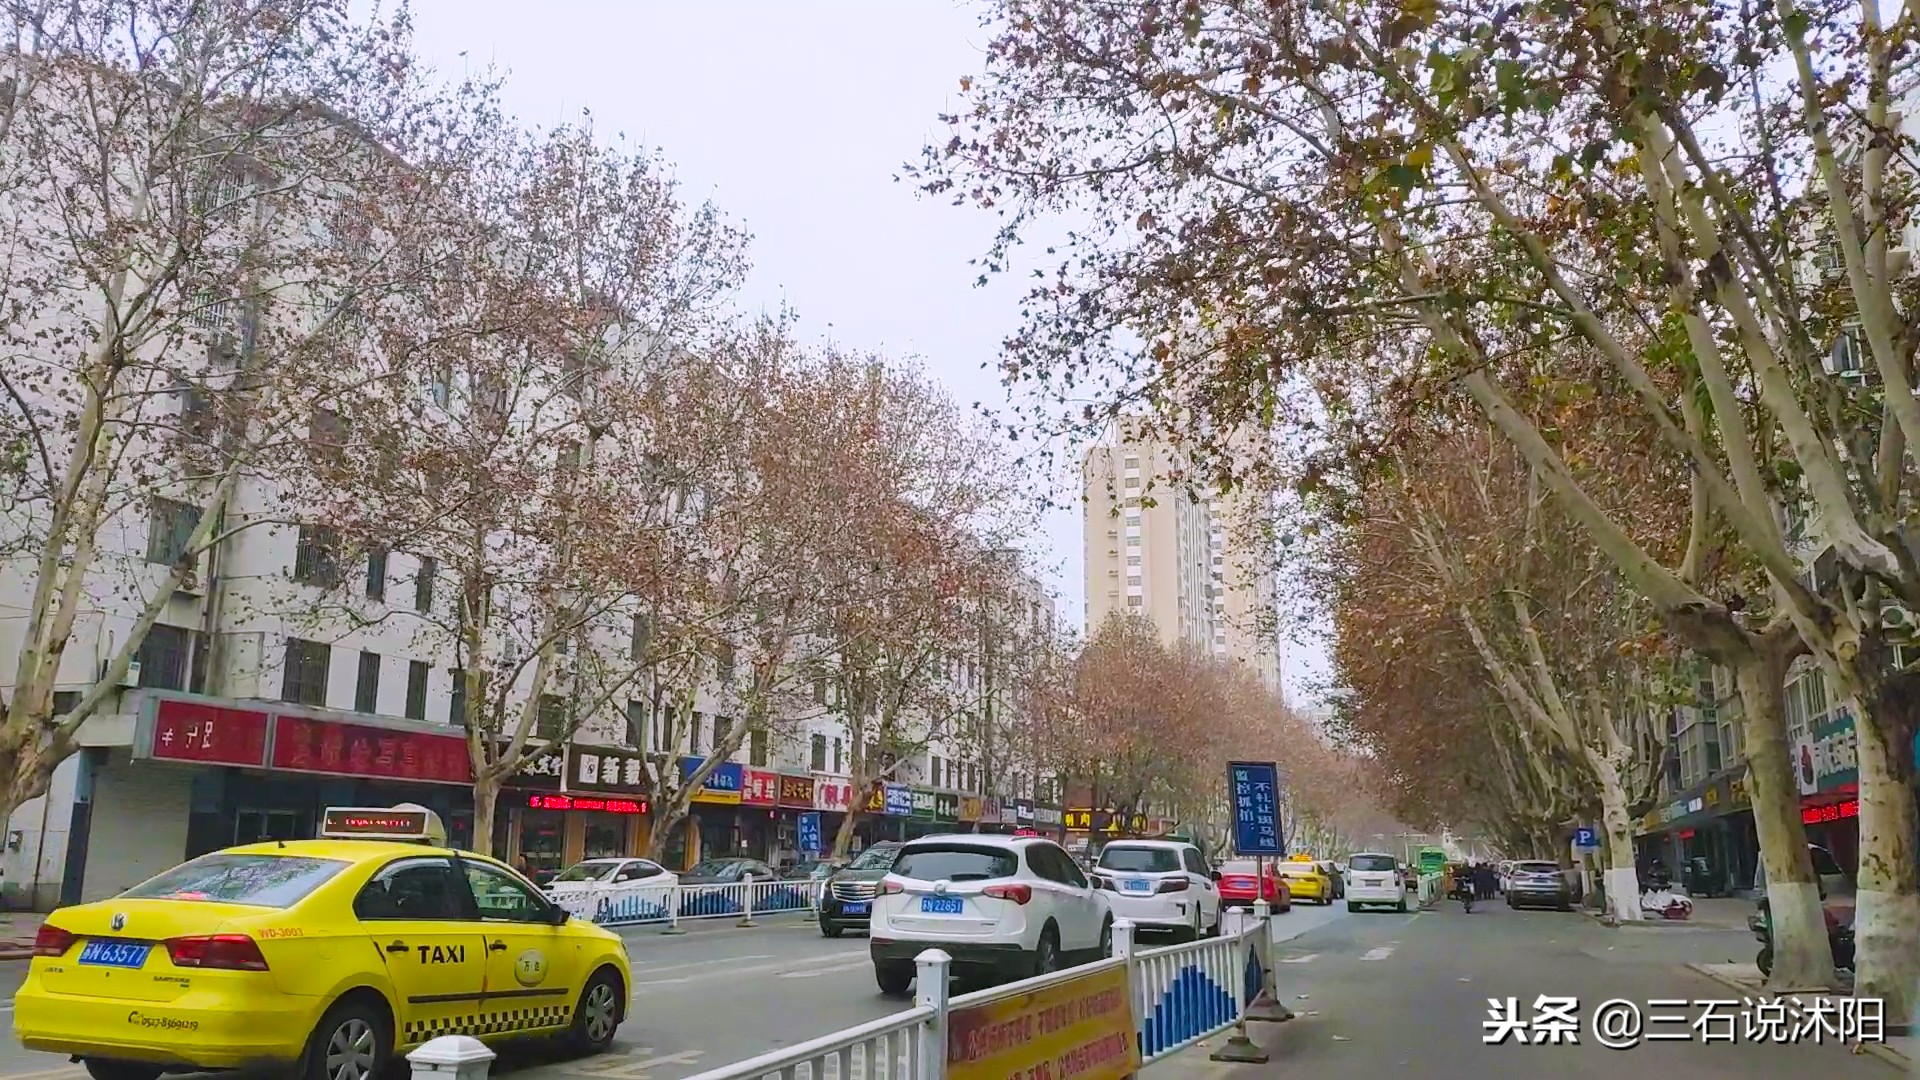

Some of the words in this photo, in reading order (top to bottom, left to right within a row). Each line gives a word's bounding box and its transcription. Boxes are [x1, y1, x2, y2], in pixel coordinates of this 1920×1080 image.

[1579, 830, 1592, 844] P
[257, 927, 304, 939] WD-3003
[417, 944, 465, 965] TAXI
